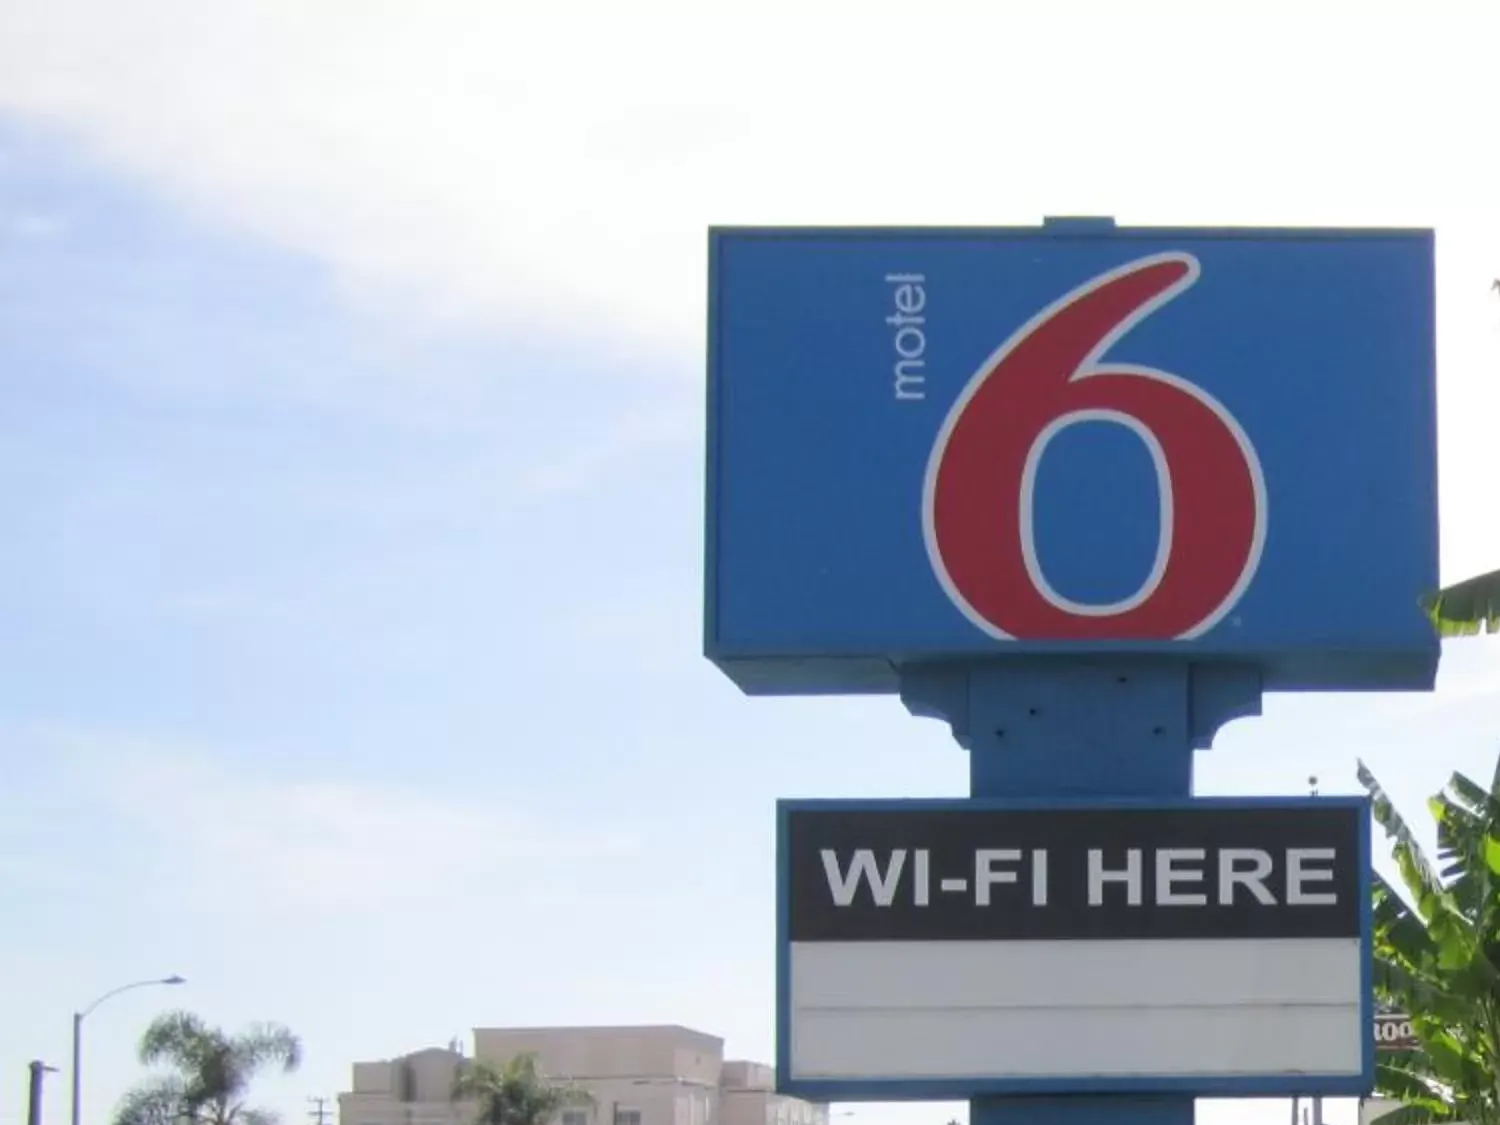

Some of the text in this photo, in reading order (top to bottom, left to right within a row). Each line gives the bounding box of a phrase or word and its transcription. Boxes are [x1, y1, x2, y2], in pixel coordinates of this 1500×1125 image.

[886, 251, 1268, 641] motel 6
[819, 847, 1338, 907] WI-FI HERE
